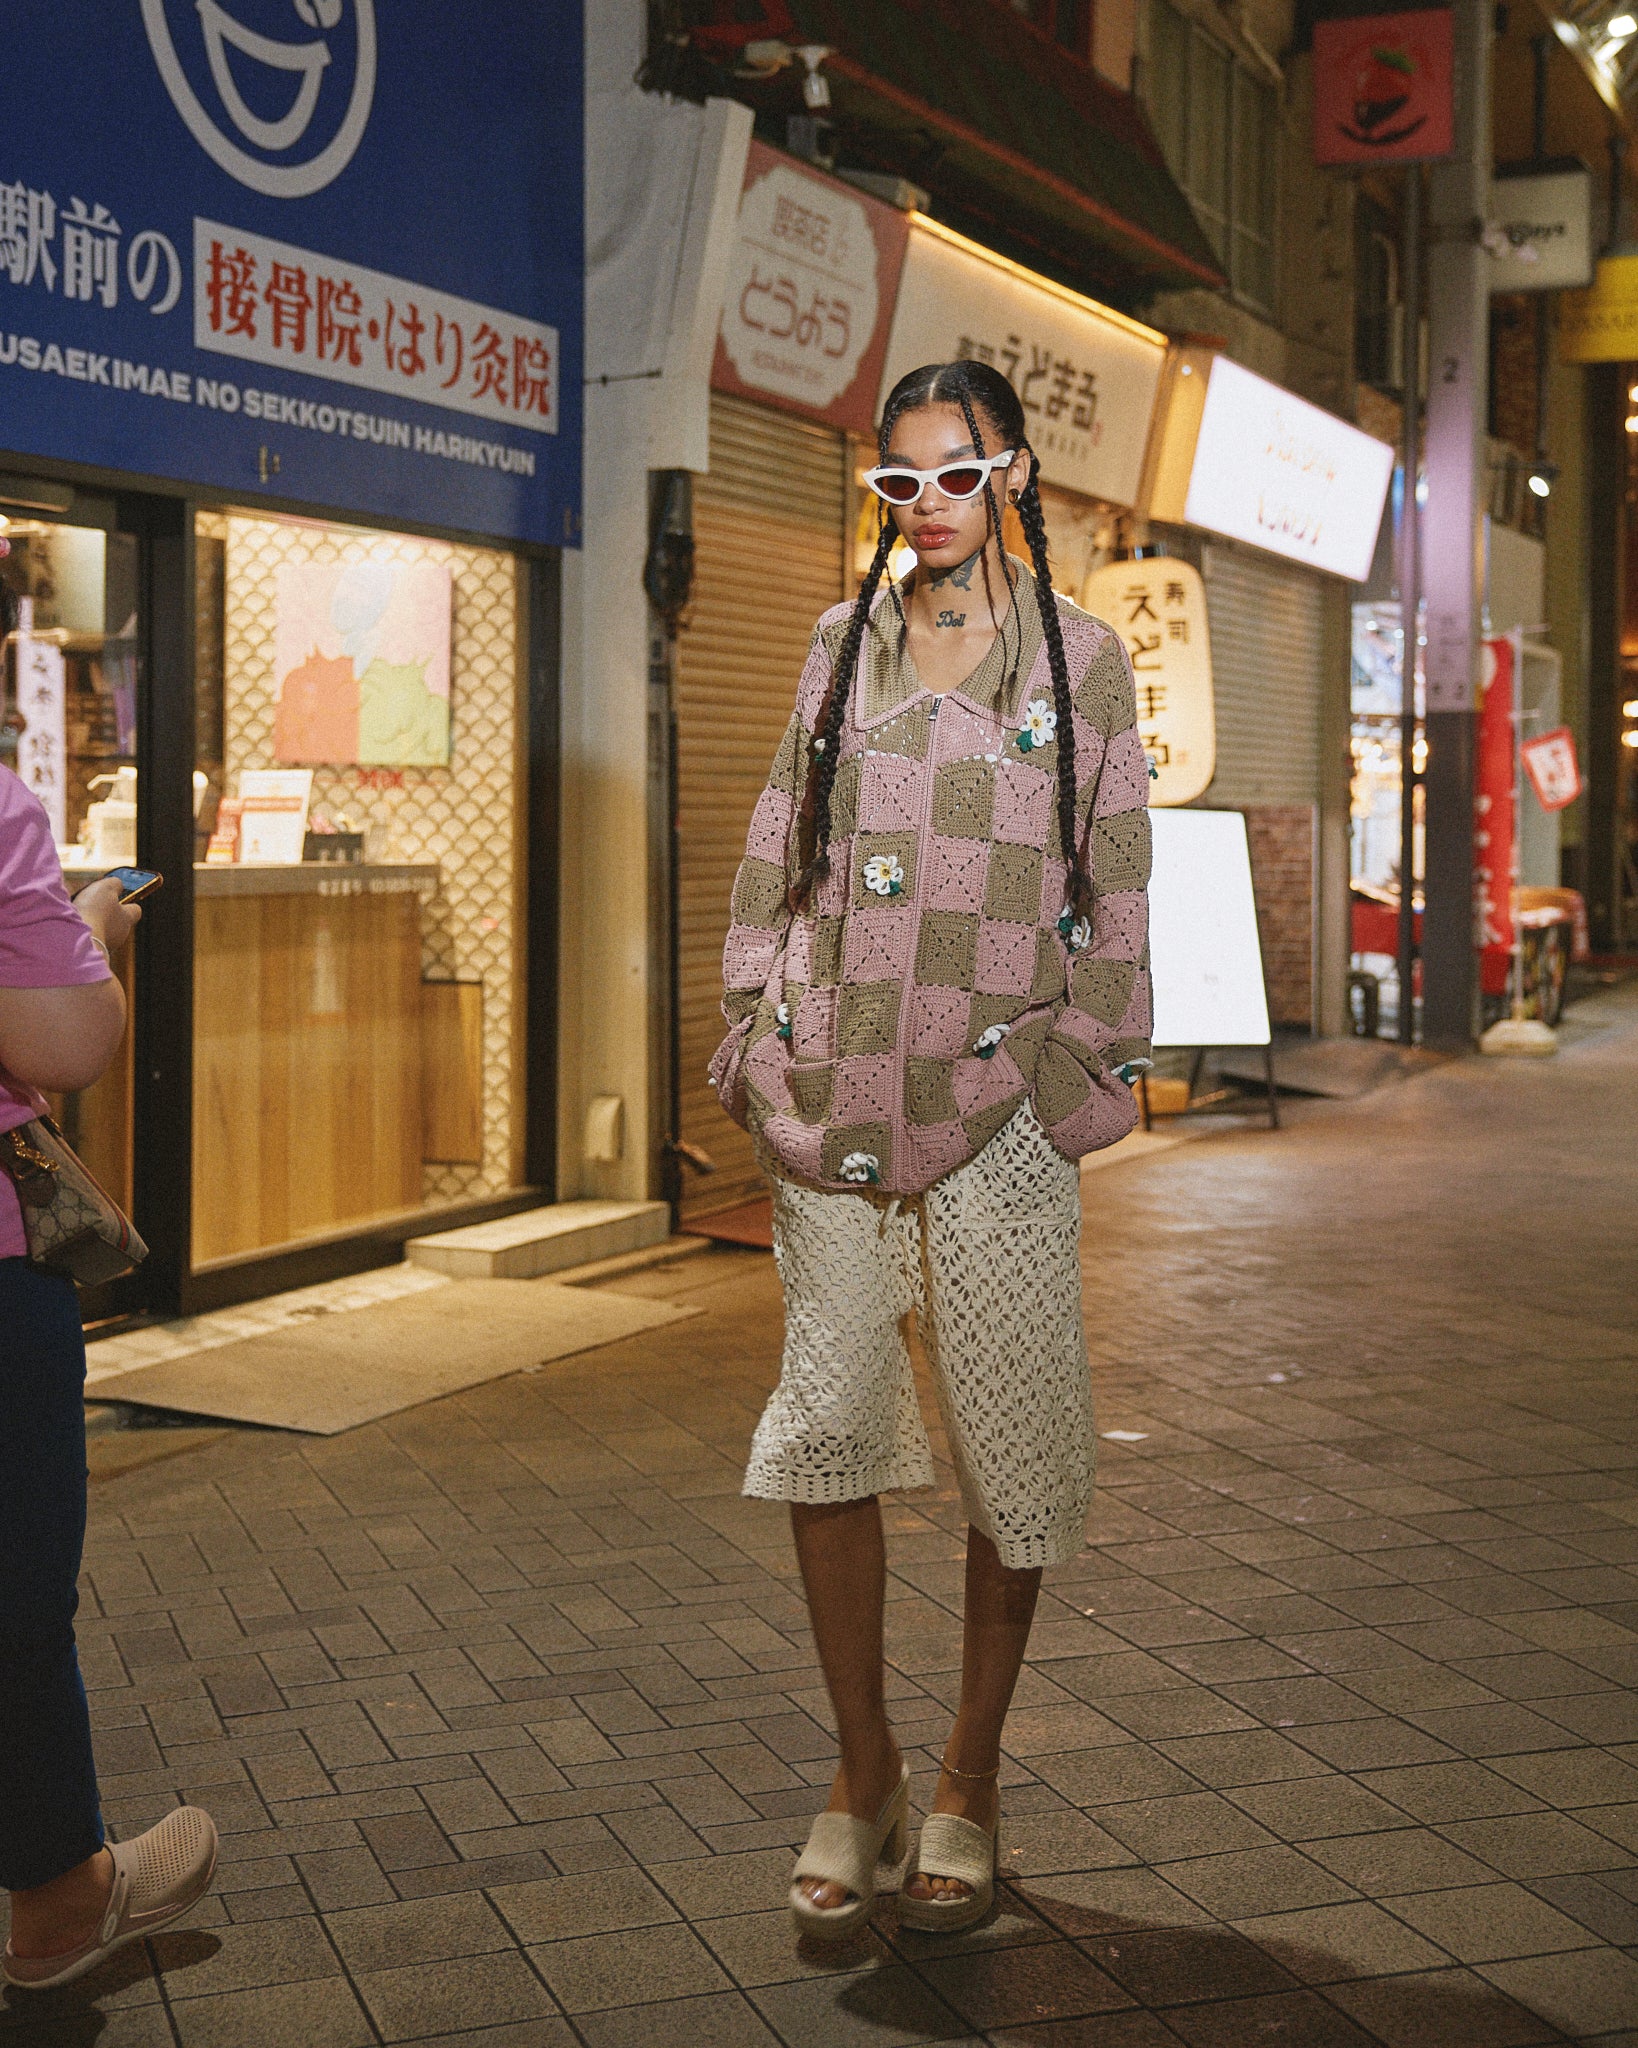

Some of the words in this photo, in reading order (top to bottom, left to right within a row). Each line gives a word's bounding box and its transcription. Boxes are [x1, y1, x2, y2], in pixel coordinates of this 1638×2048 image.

[739, 265, 851, 359] とうよう
[0, 331, 192, 403] USAEKIMAE
[196, 377, 241, 414] NO
[243, 388, 411, 450] SEKKOTSUIN
[414, 426, 536, 477] HARIKYUIN
[936, 610, 966, 628] Doll
[1165, 582, 1188, 645] 寿司
